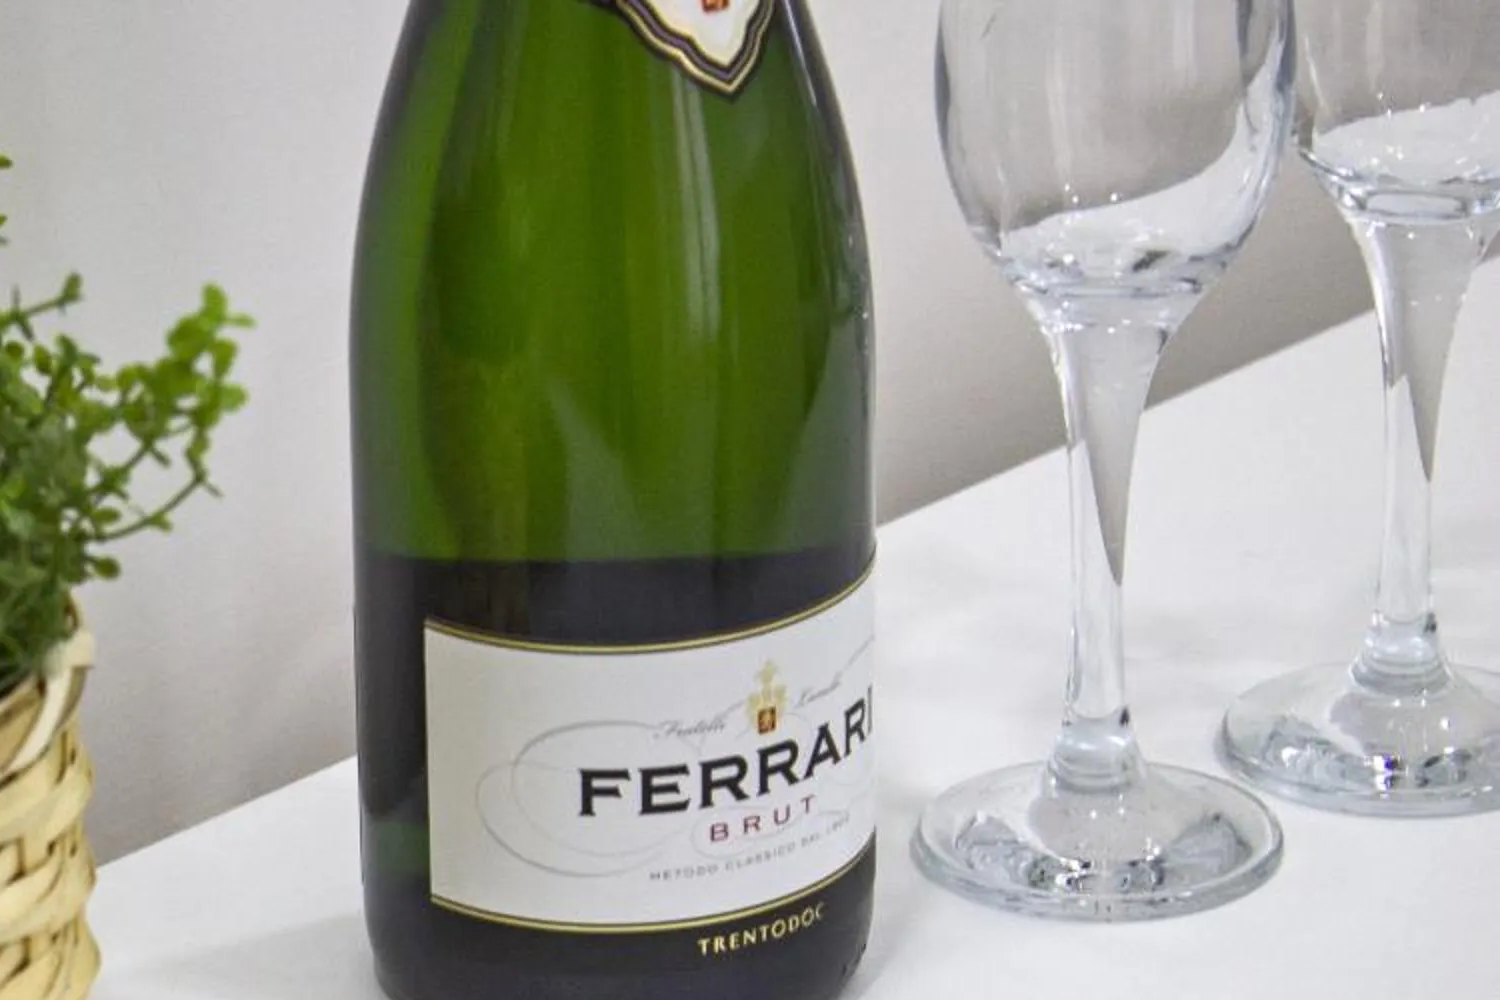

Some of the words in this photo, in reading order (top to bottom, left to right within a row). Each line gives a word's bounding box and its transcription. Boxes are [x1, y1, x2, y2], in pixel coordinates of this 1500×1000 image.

[579, 683, 872, 816] FERRARI
[710, 794, 815, 843] BRUT
[649, 863, 719, 881] METODO
[725, 841, 796, 872] CLASSICO
[697, 902, 825, 956] TRENTODOC
